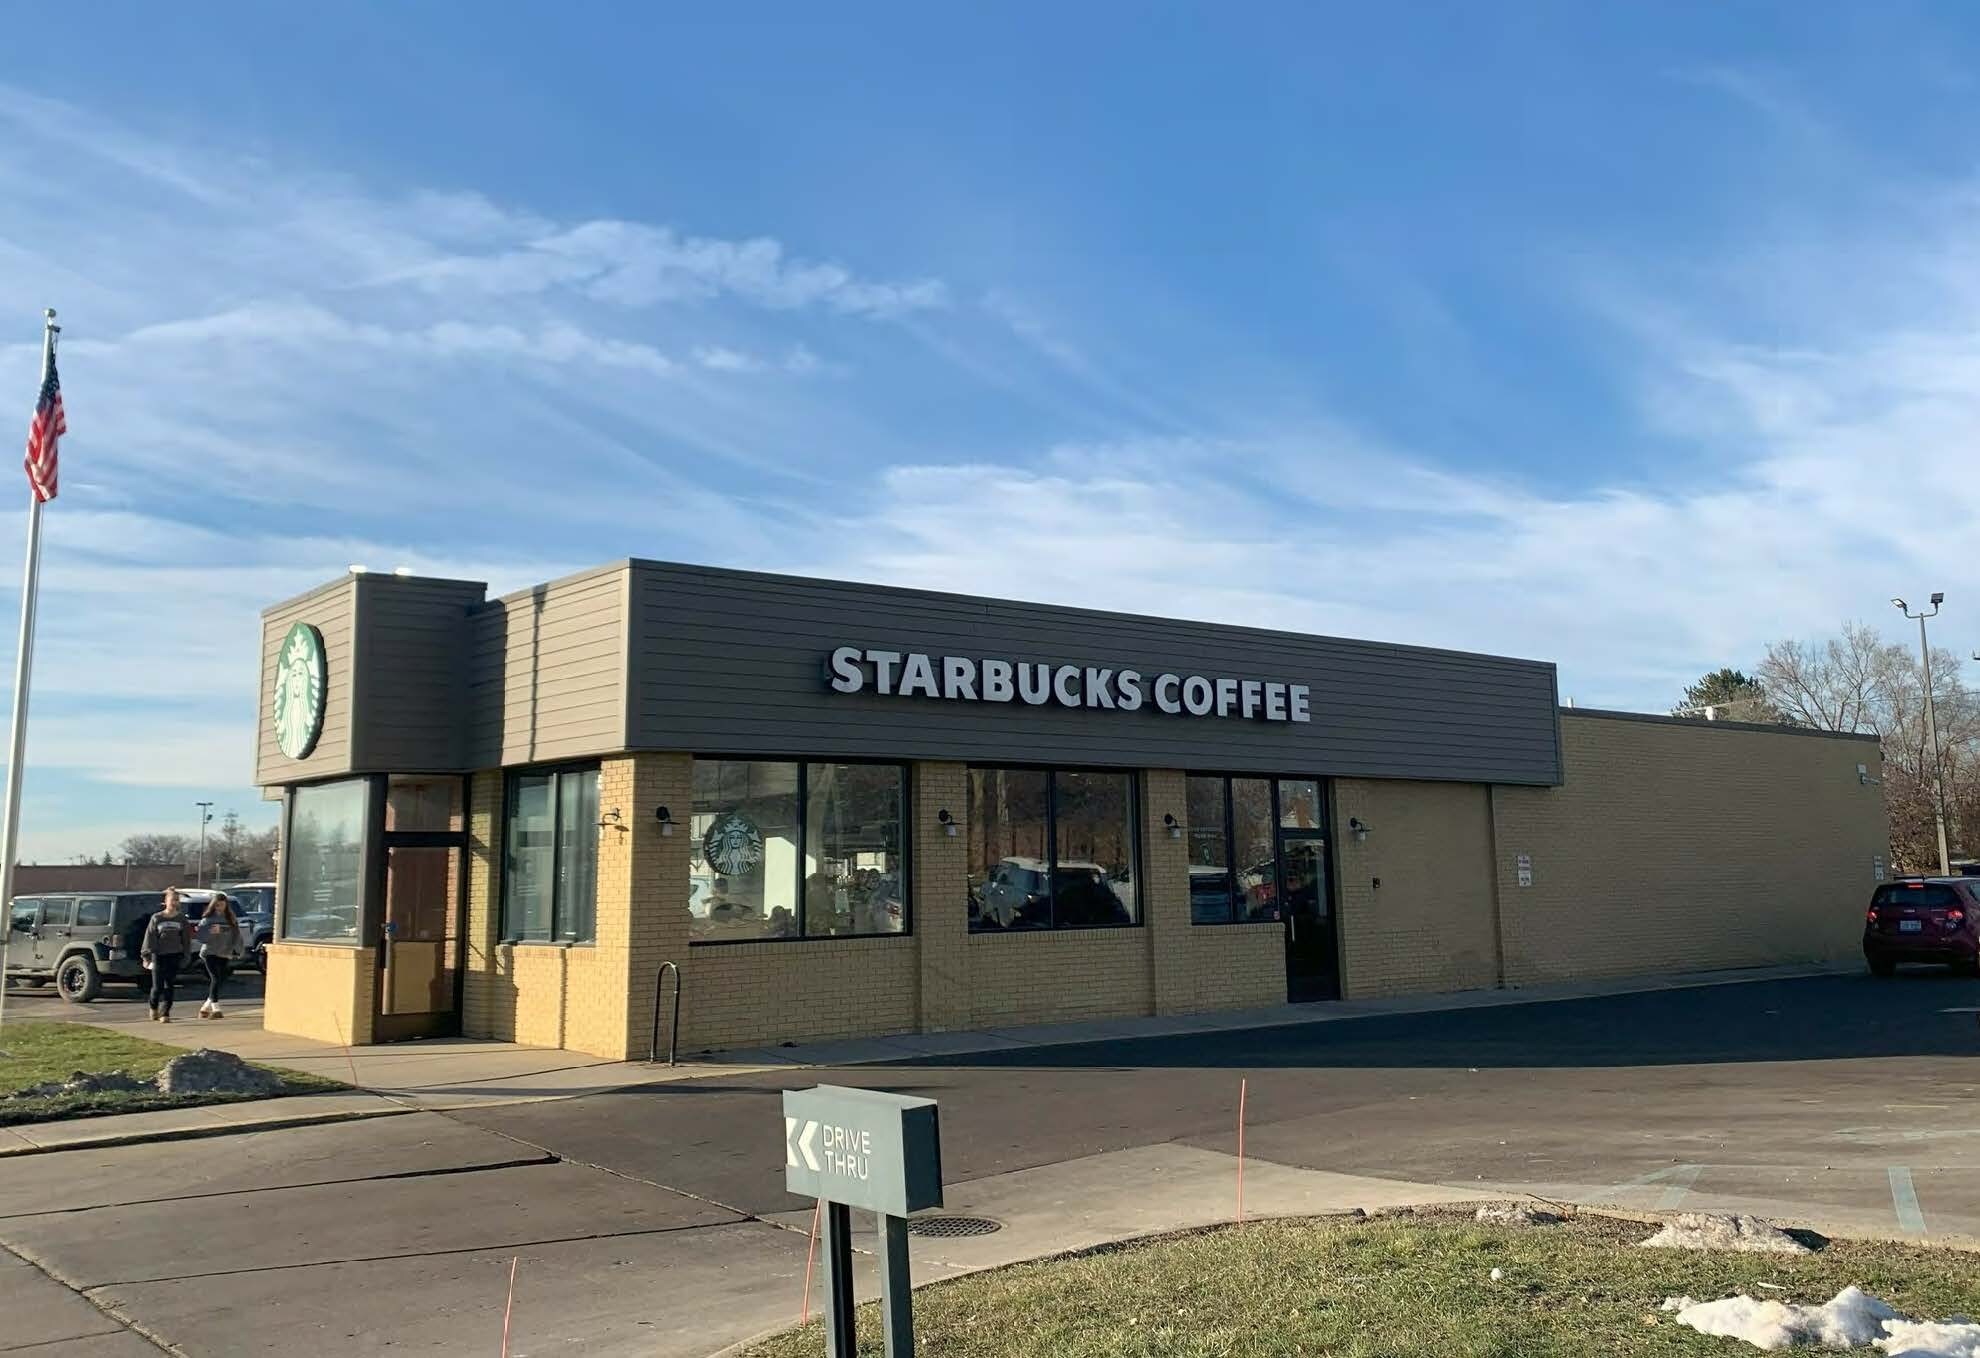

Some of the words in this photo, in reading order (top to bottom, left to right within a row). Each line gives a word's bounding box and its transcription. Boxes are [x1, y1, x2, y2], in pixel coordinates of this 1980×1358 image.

[831, 646, 1143, 711] STARBUCKS
[1154, 673, 1311, 723] COFFEE
[823, 1125, 871, 1154] DRIVE
[824, 1150, 868, 1180] THRU
